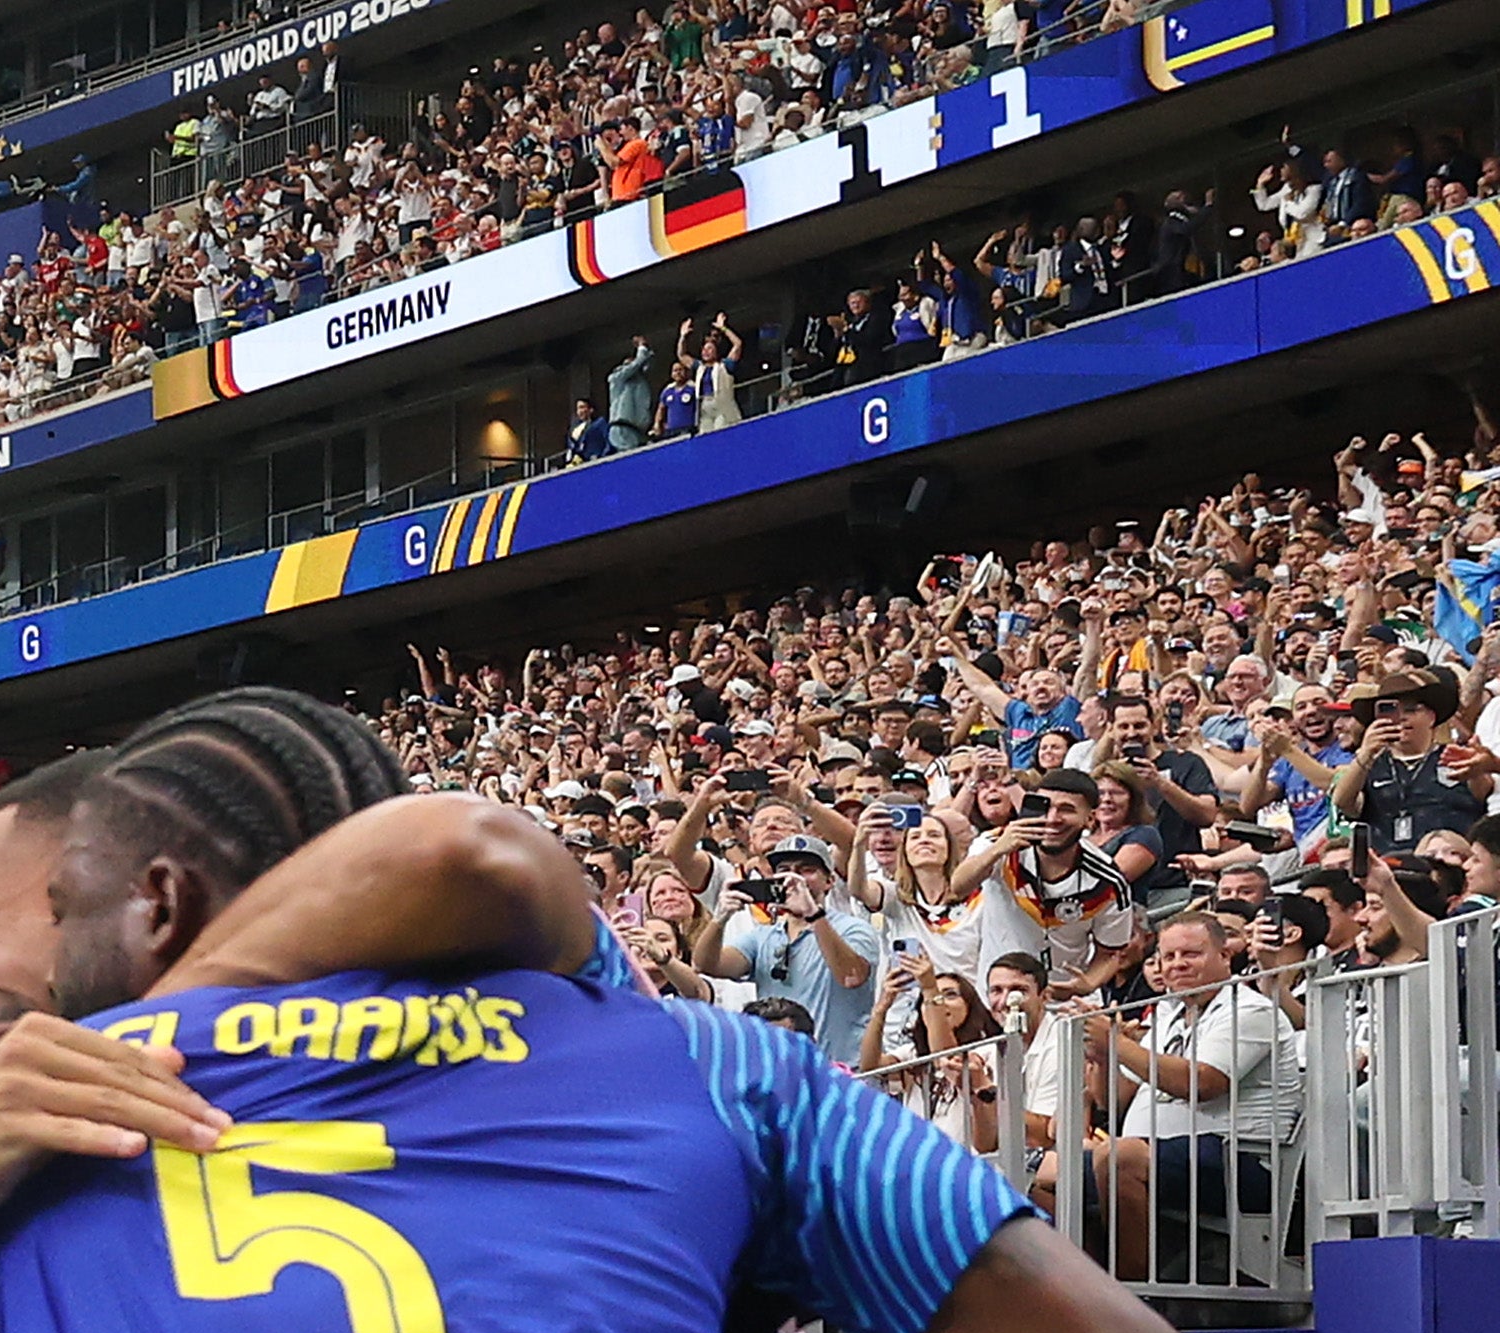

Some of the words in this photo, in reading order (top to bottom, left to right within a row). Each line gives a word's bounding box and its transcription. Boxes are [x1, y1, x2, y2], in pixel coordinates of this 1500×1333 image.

[173, 58, 219, 97] FIFA
[220, 28, 300, 79] WORLD
[301, 10, 348, 49] CUP
[990, 66, 1041, 149] 1
[1445, 226, 1474, 279] G
[327, 281, 451, 350] GERMANY
[863, 398, 888, 444] G
[405, 526, 426, 566] G
[22, 625, 40, 661] G
